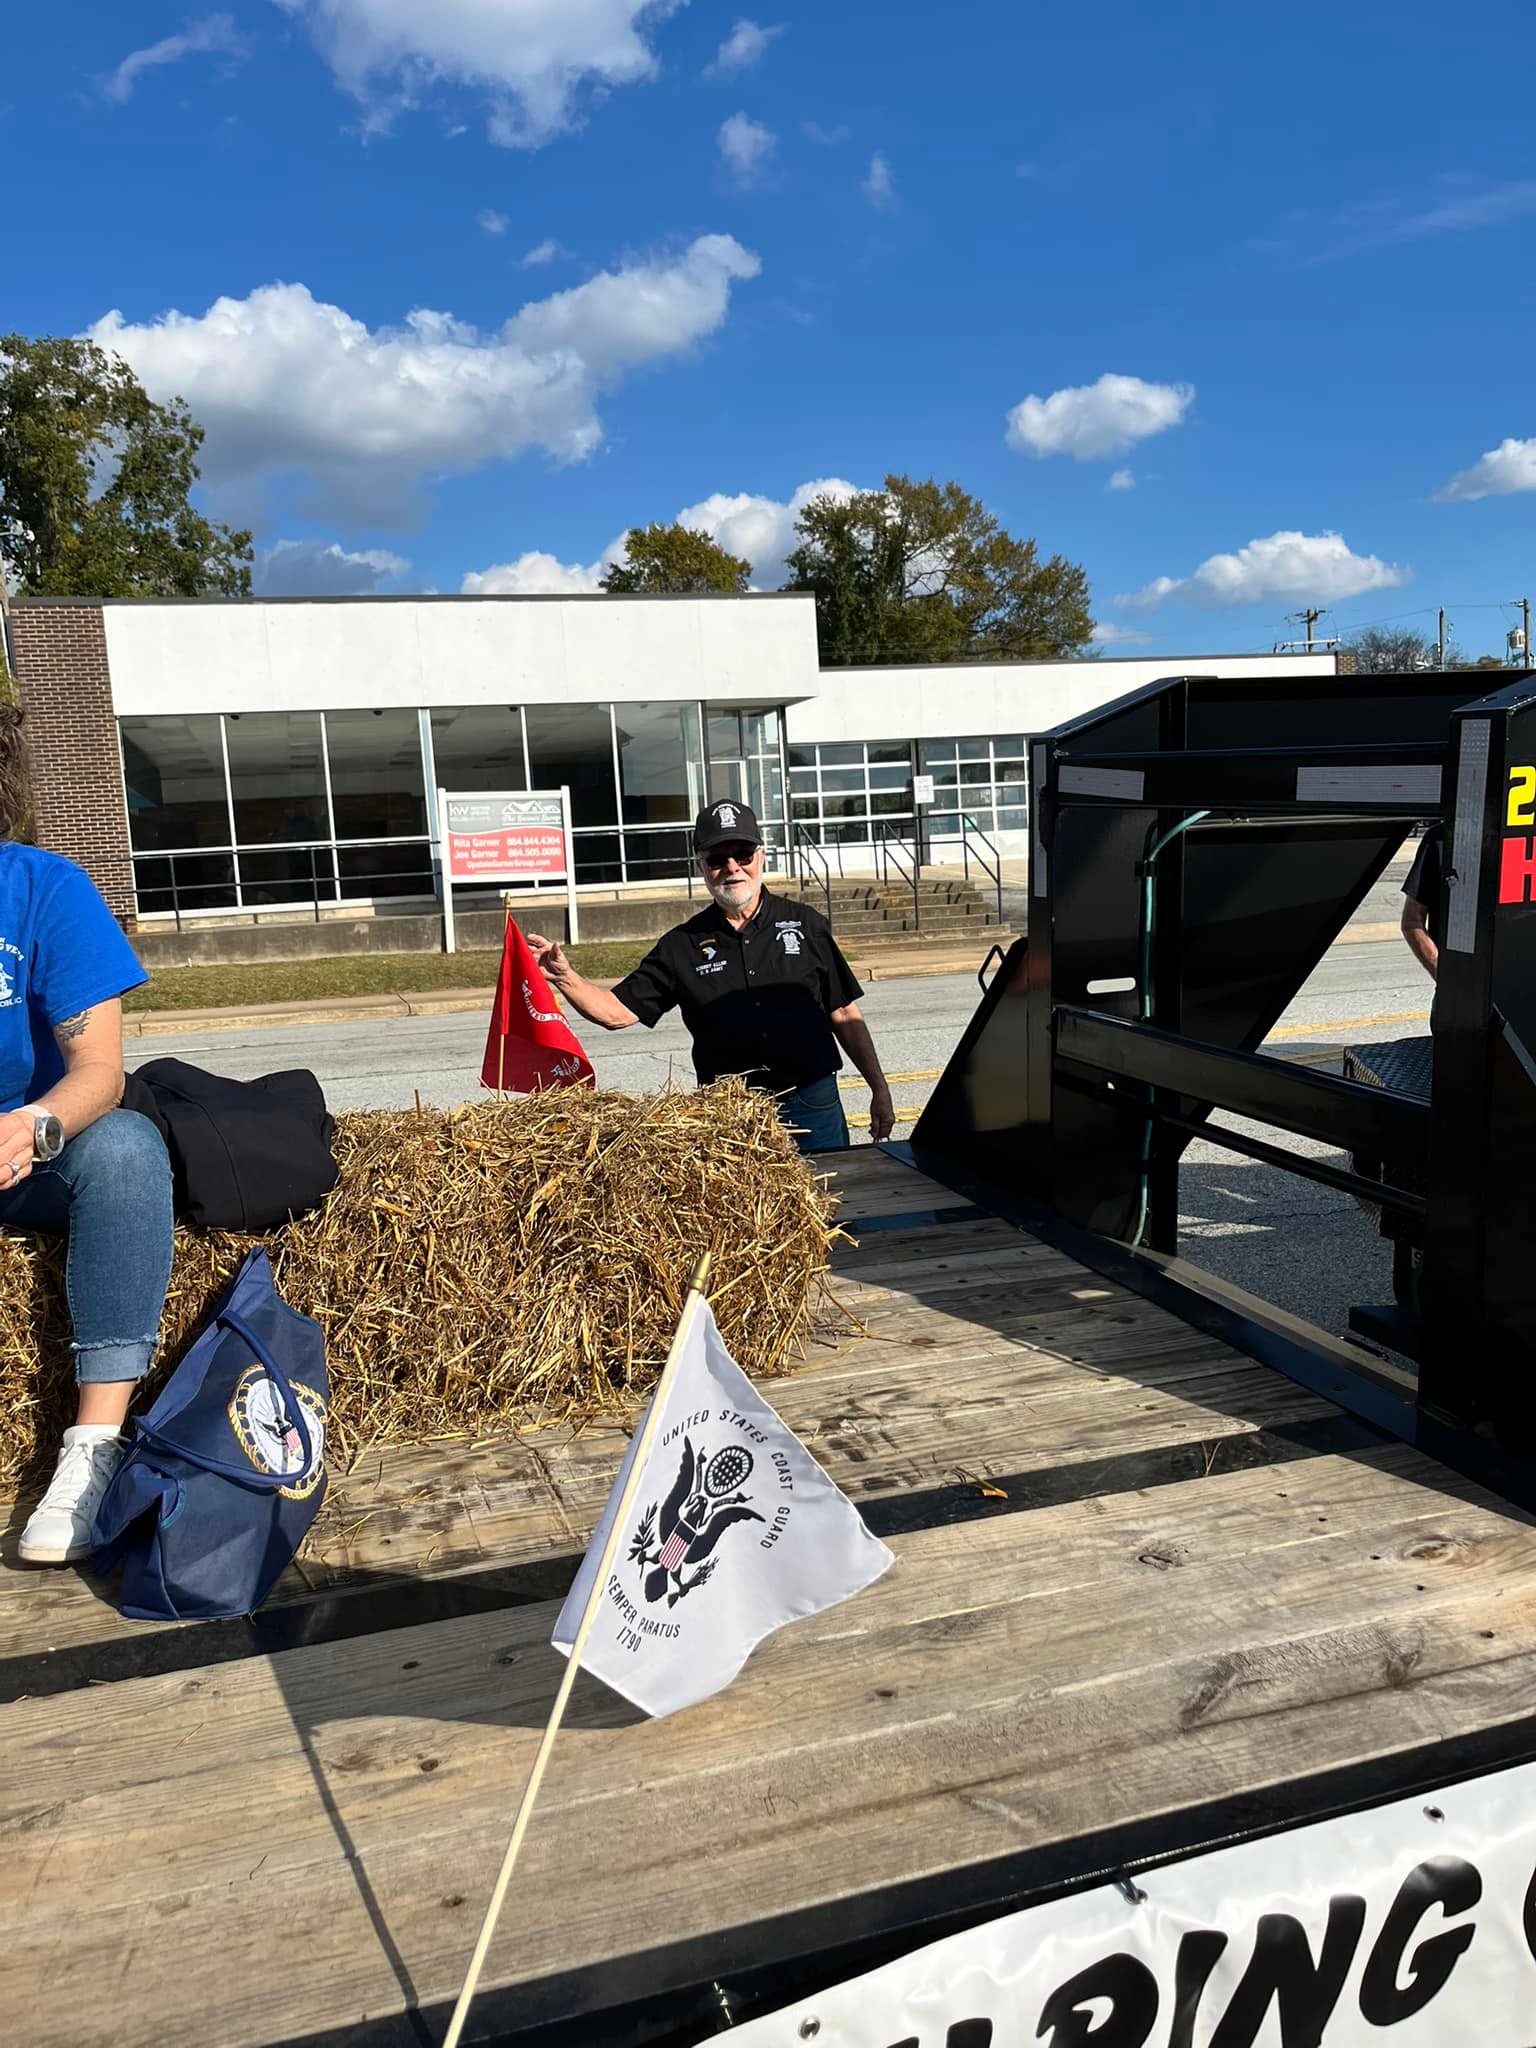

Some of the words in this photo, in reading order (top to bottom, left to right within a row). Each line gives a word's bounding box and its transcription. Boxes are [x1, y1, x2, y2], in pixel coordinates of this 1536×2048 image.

[453, 839, 470, 848] Rita
[472, 838, 500, 848] Garner
[454, 850, 469, 859] Joe
[471, 850, 499, 858] Garner
[662, 1409, 710, 1447] UNITED
[719, 1409, 769, 1445] STATES
[770, 1451, 793, 1491] COAST
[760, 1506, 791, 1550] GUARD
[607, 1574, 638, 1623] SEMPER
[638, 1616, 681, 1639] PARATUS
[616, 1625, 642, 1652] 1790
